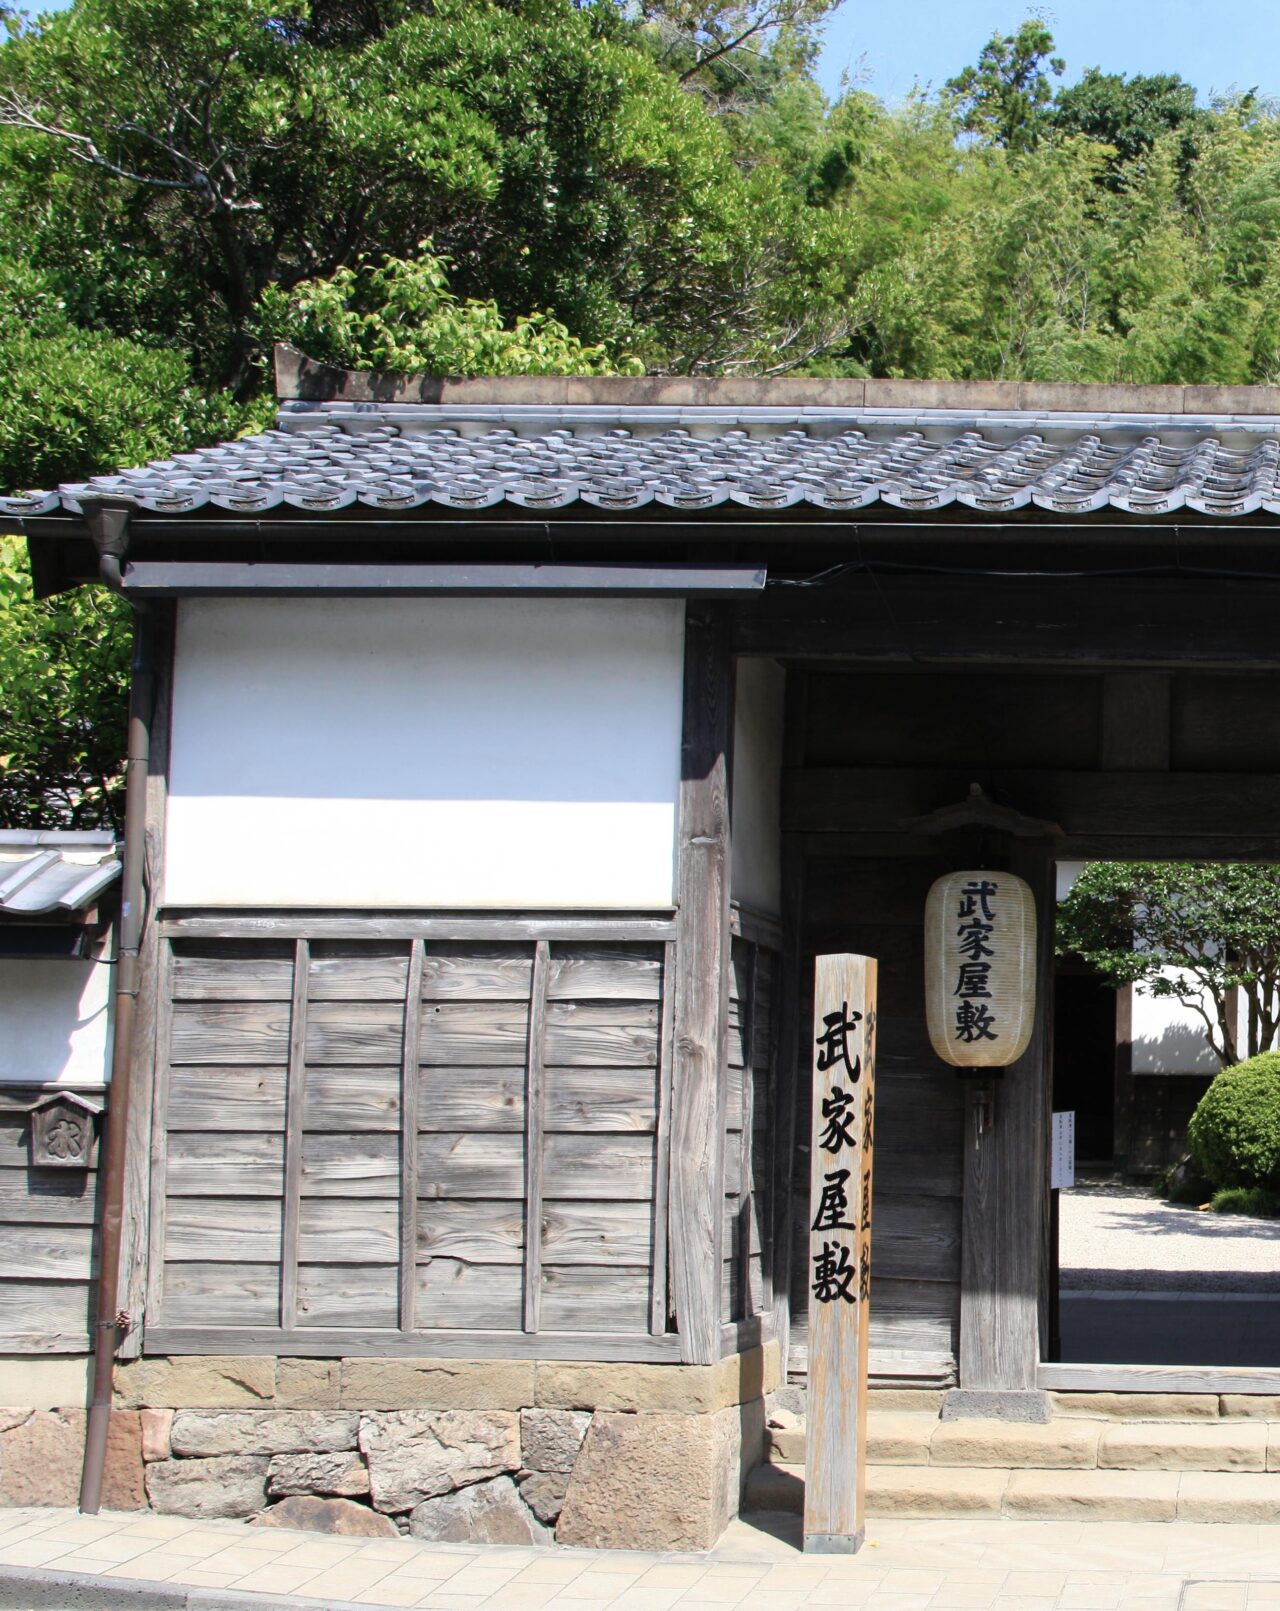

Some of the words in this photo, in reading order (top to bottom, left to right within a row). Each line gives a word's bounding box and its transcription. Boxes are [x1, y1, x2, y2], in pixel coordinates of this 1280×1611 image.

[953, 881, 998, 1043] 武家屋敷
[811, 1001, 862, 1304] 武家屋敷
